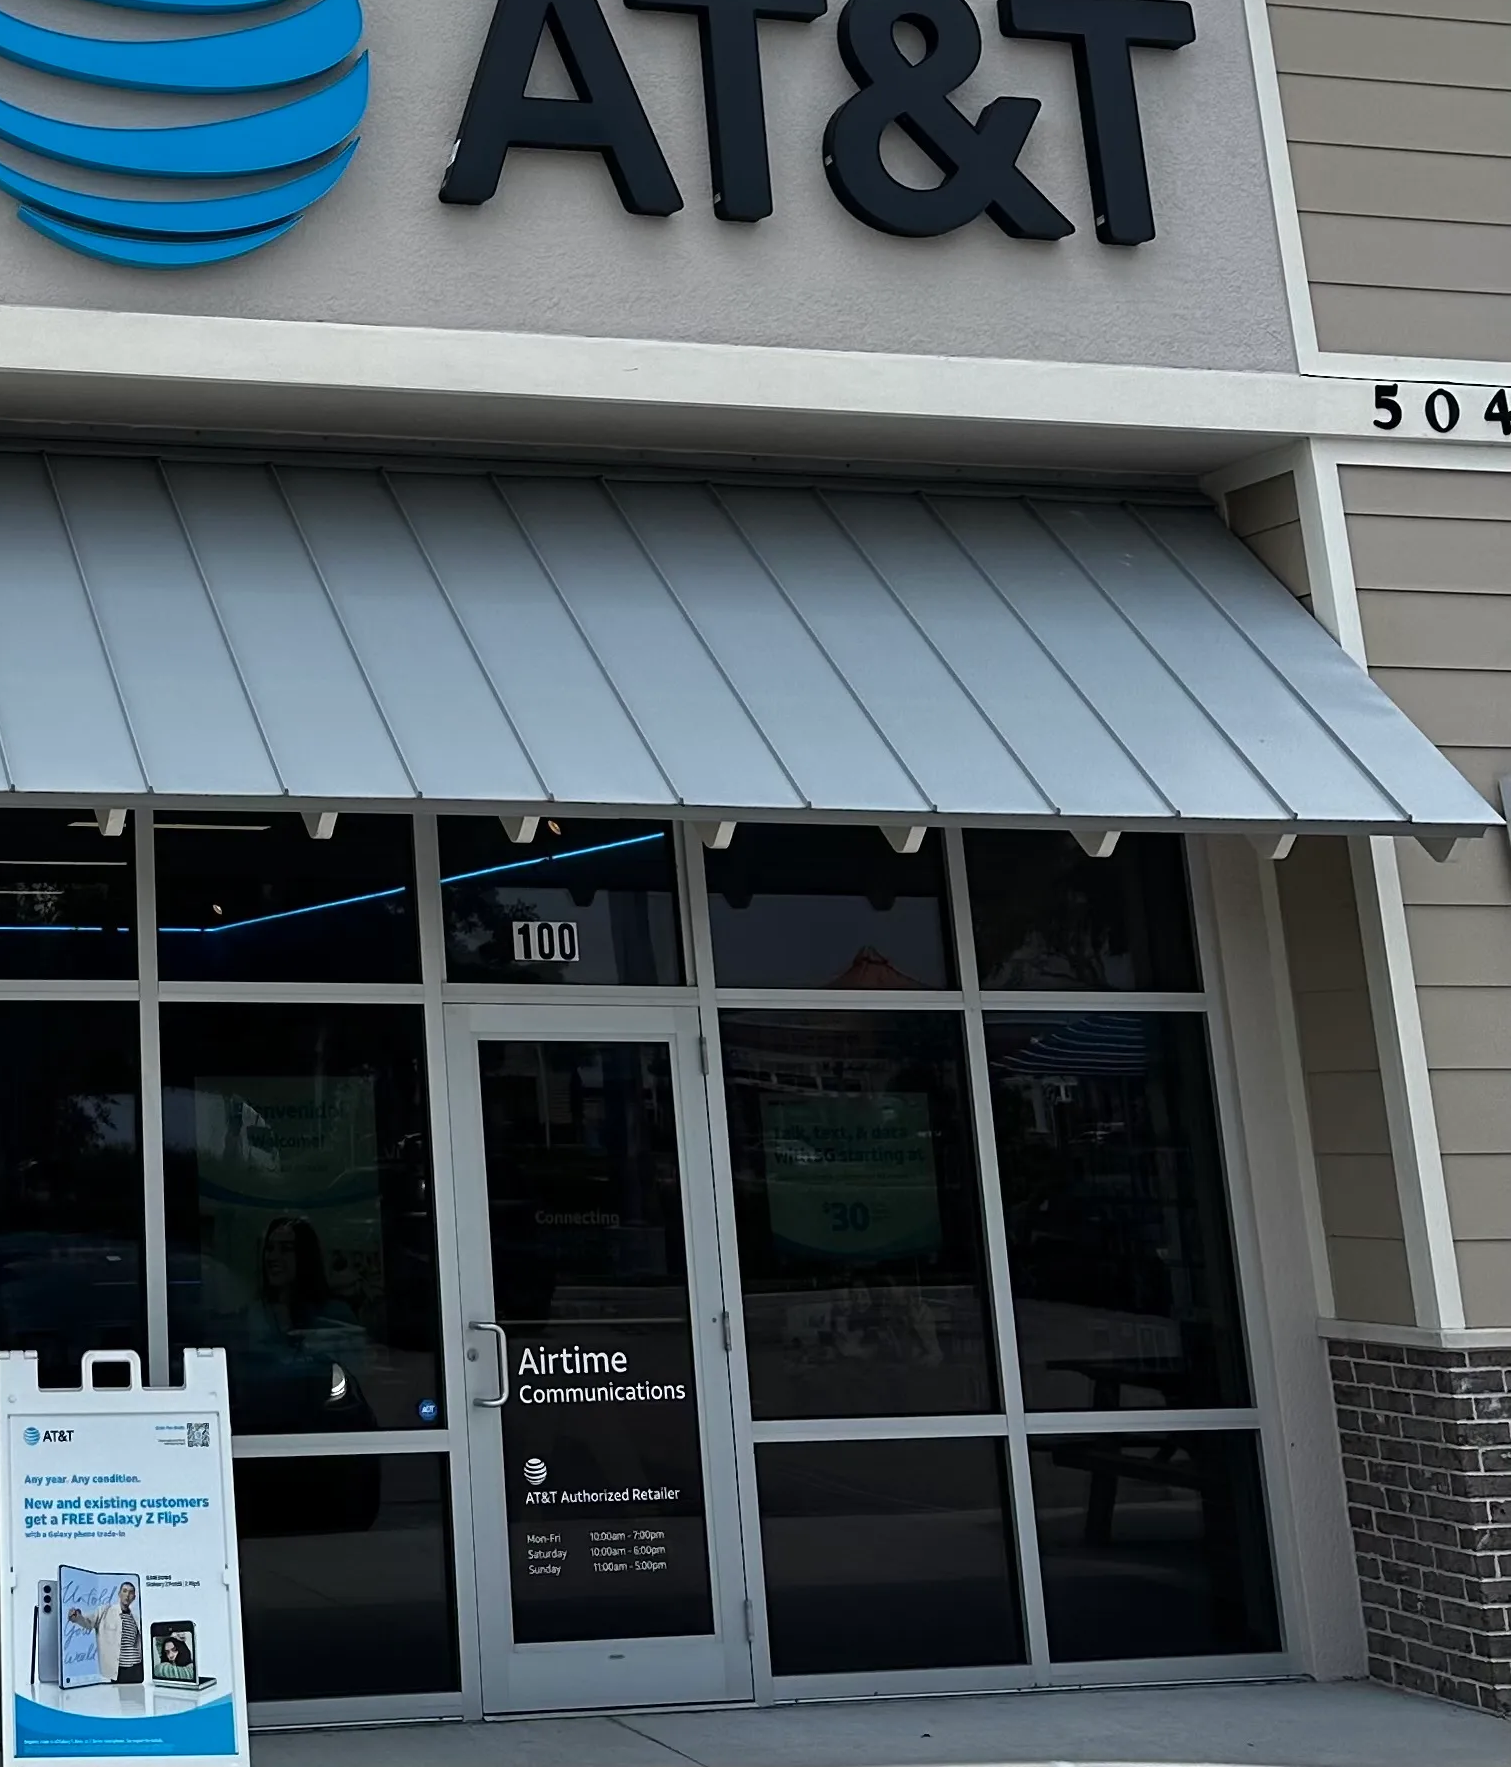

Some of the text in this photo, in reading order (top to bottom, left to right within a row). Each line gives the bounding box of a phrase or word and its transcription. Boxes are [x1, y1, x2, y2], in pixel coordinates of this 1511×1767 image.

[517, 923, 576, 961] 100
[534, 1207, 620, 1227] Connecting
[518, 1345, 627, 1375] Airtime
[519, 1381, 686, 1404] Communications
[42, 1429, 74, 1442] AT&T
[24, 1475, 43, 1486] Any
[71, 1474, 90, 1485] Any
[92, 1473, 141, 1484] condition.
[24, 1496, 210, 1511] New and existing customers
[526, 1487, 680, 1505] AT&T Authorized Retailer
[25, 1511, 189, 1528] get a FREE Galaxy Z Flip5
[527, 1534, 561, 1544] Mon-Fri
[528, 1549, 567, 1560] Saturday
[529, 1564, 561, 1576] Sunday
